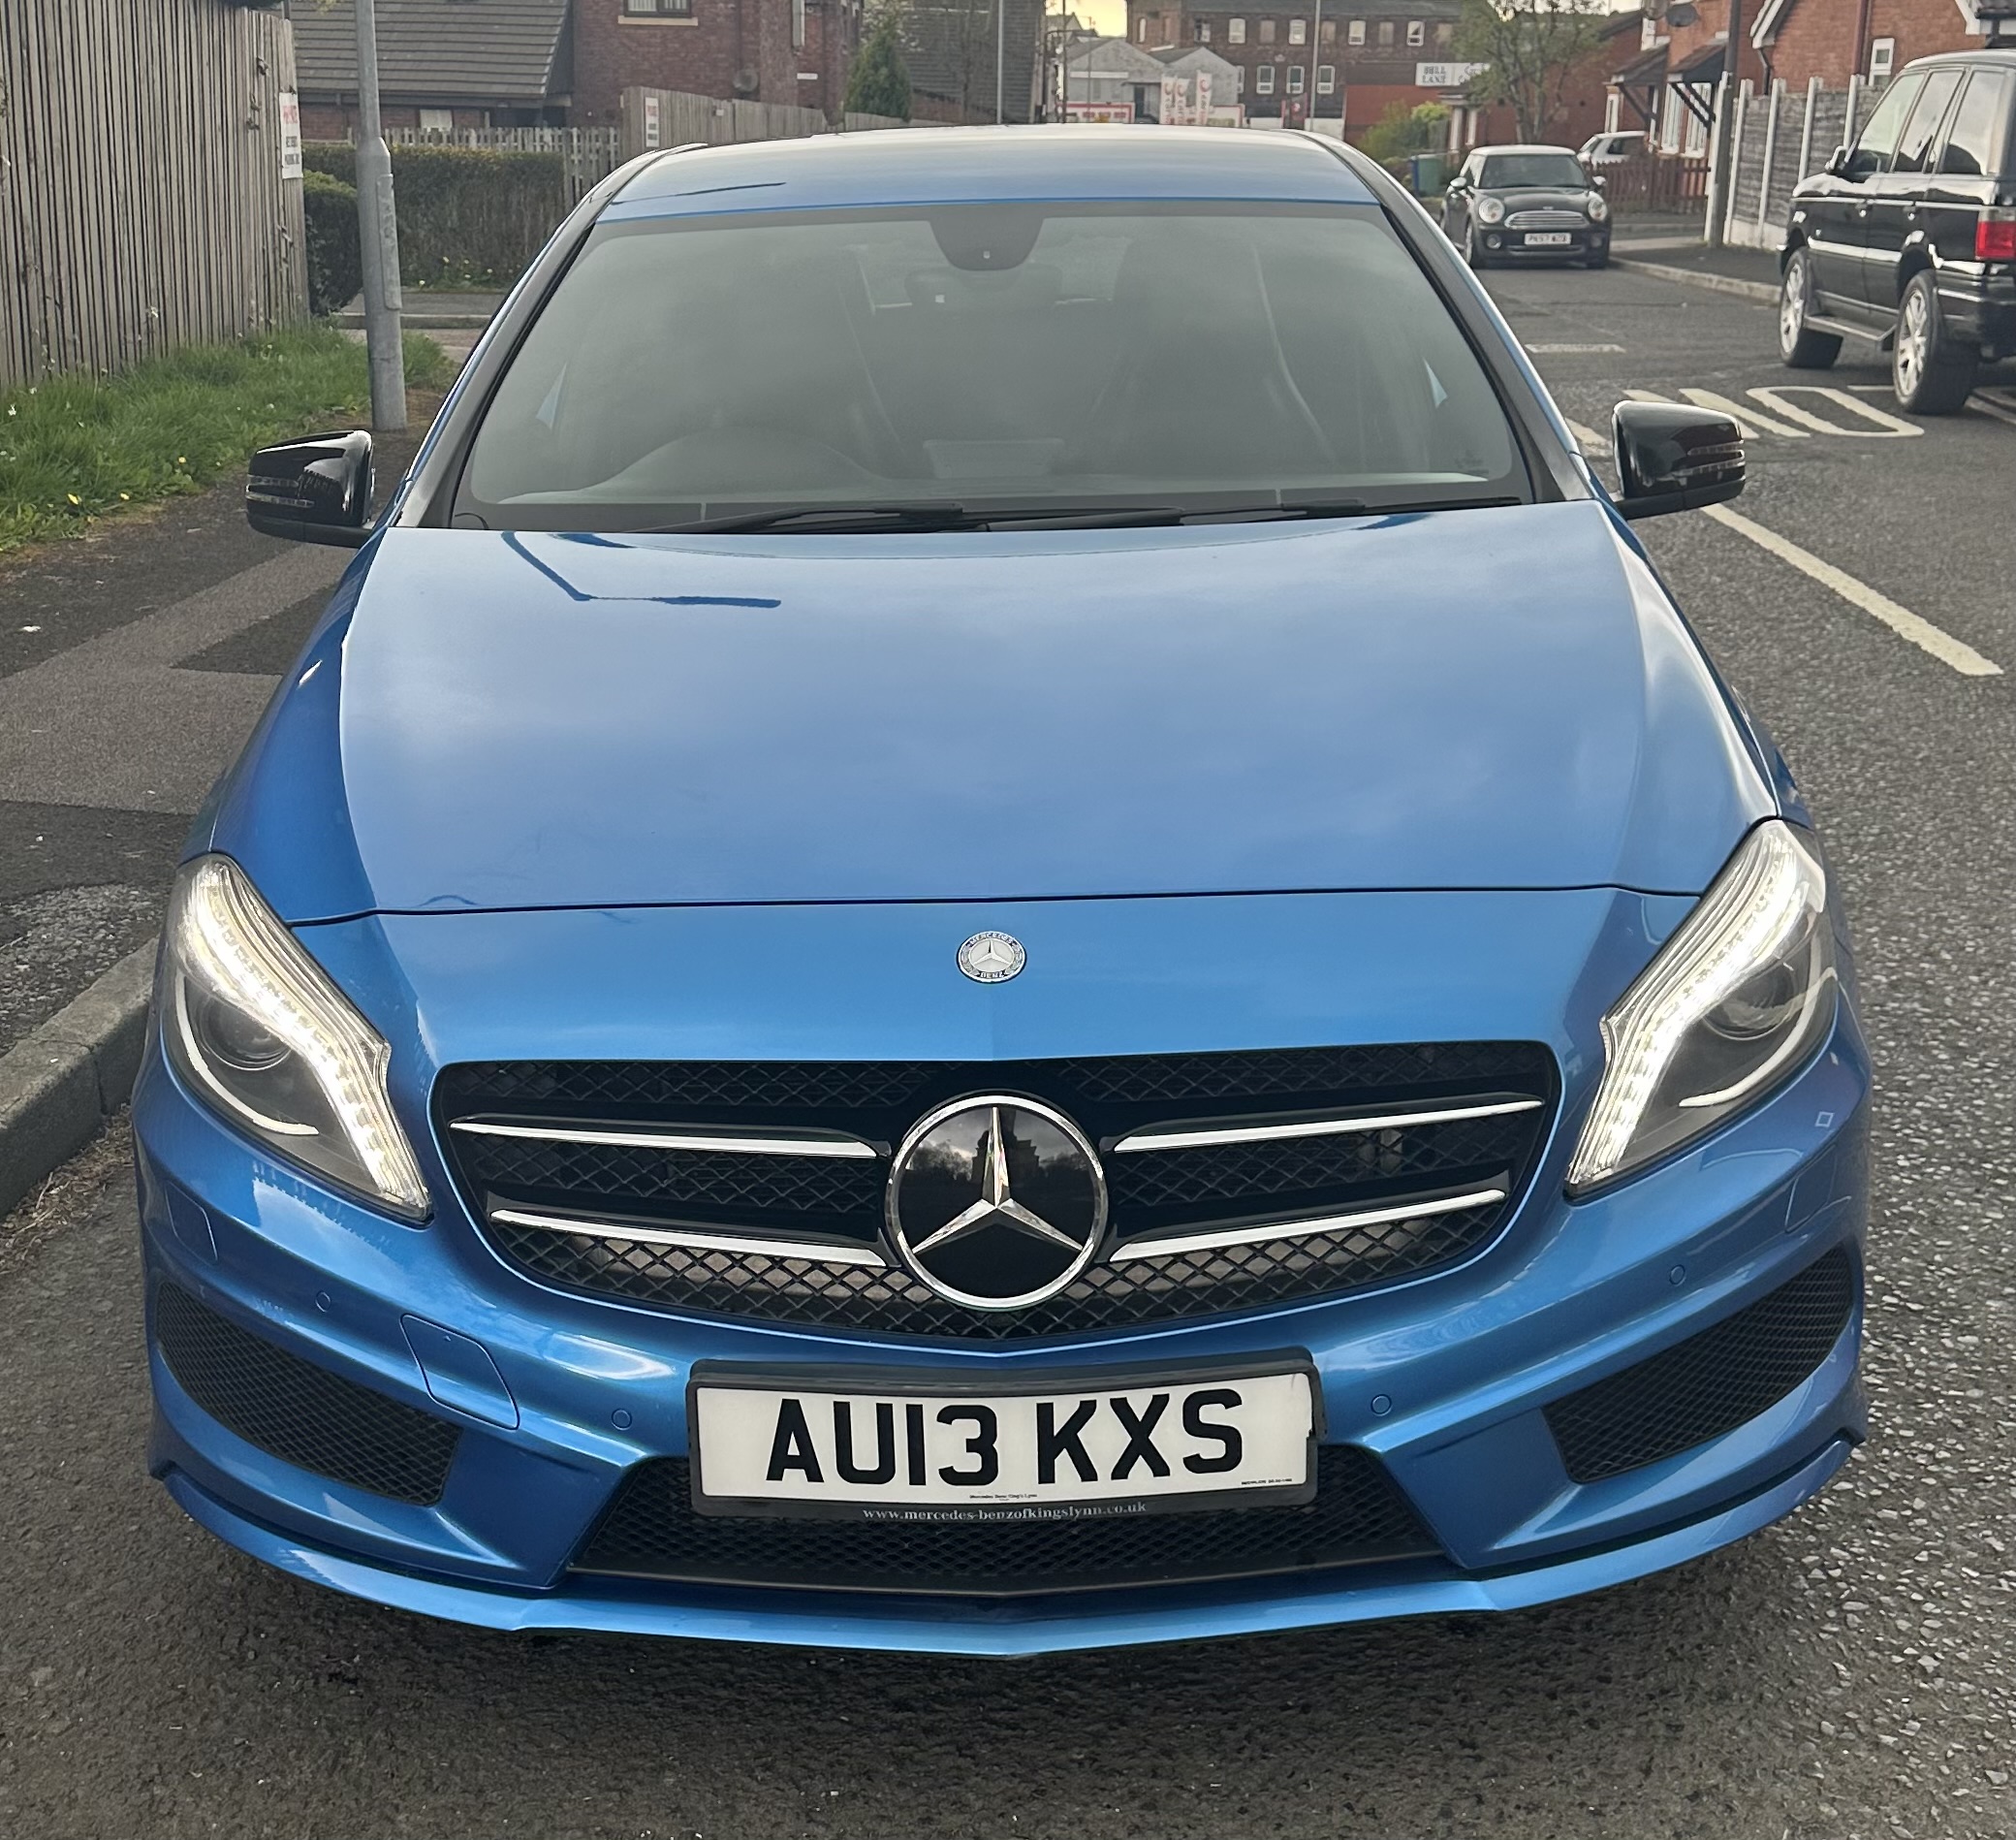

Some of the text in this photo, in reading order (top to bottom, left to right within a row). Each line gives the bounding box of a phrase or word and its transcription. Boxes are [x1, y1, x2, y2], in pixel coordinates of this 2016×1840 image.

[766, 1388, 1243, 1486] AU13 KXS
[863, 1502, 1147, 1521] www.mercedes-benzofkingslynn.co.uk
